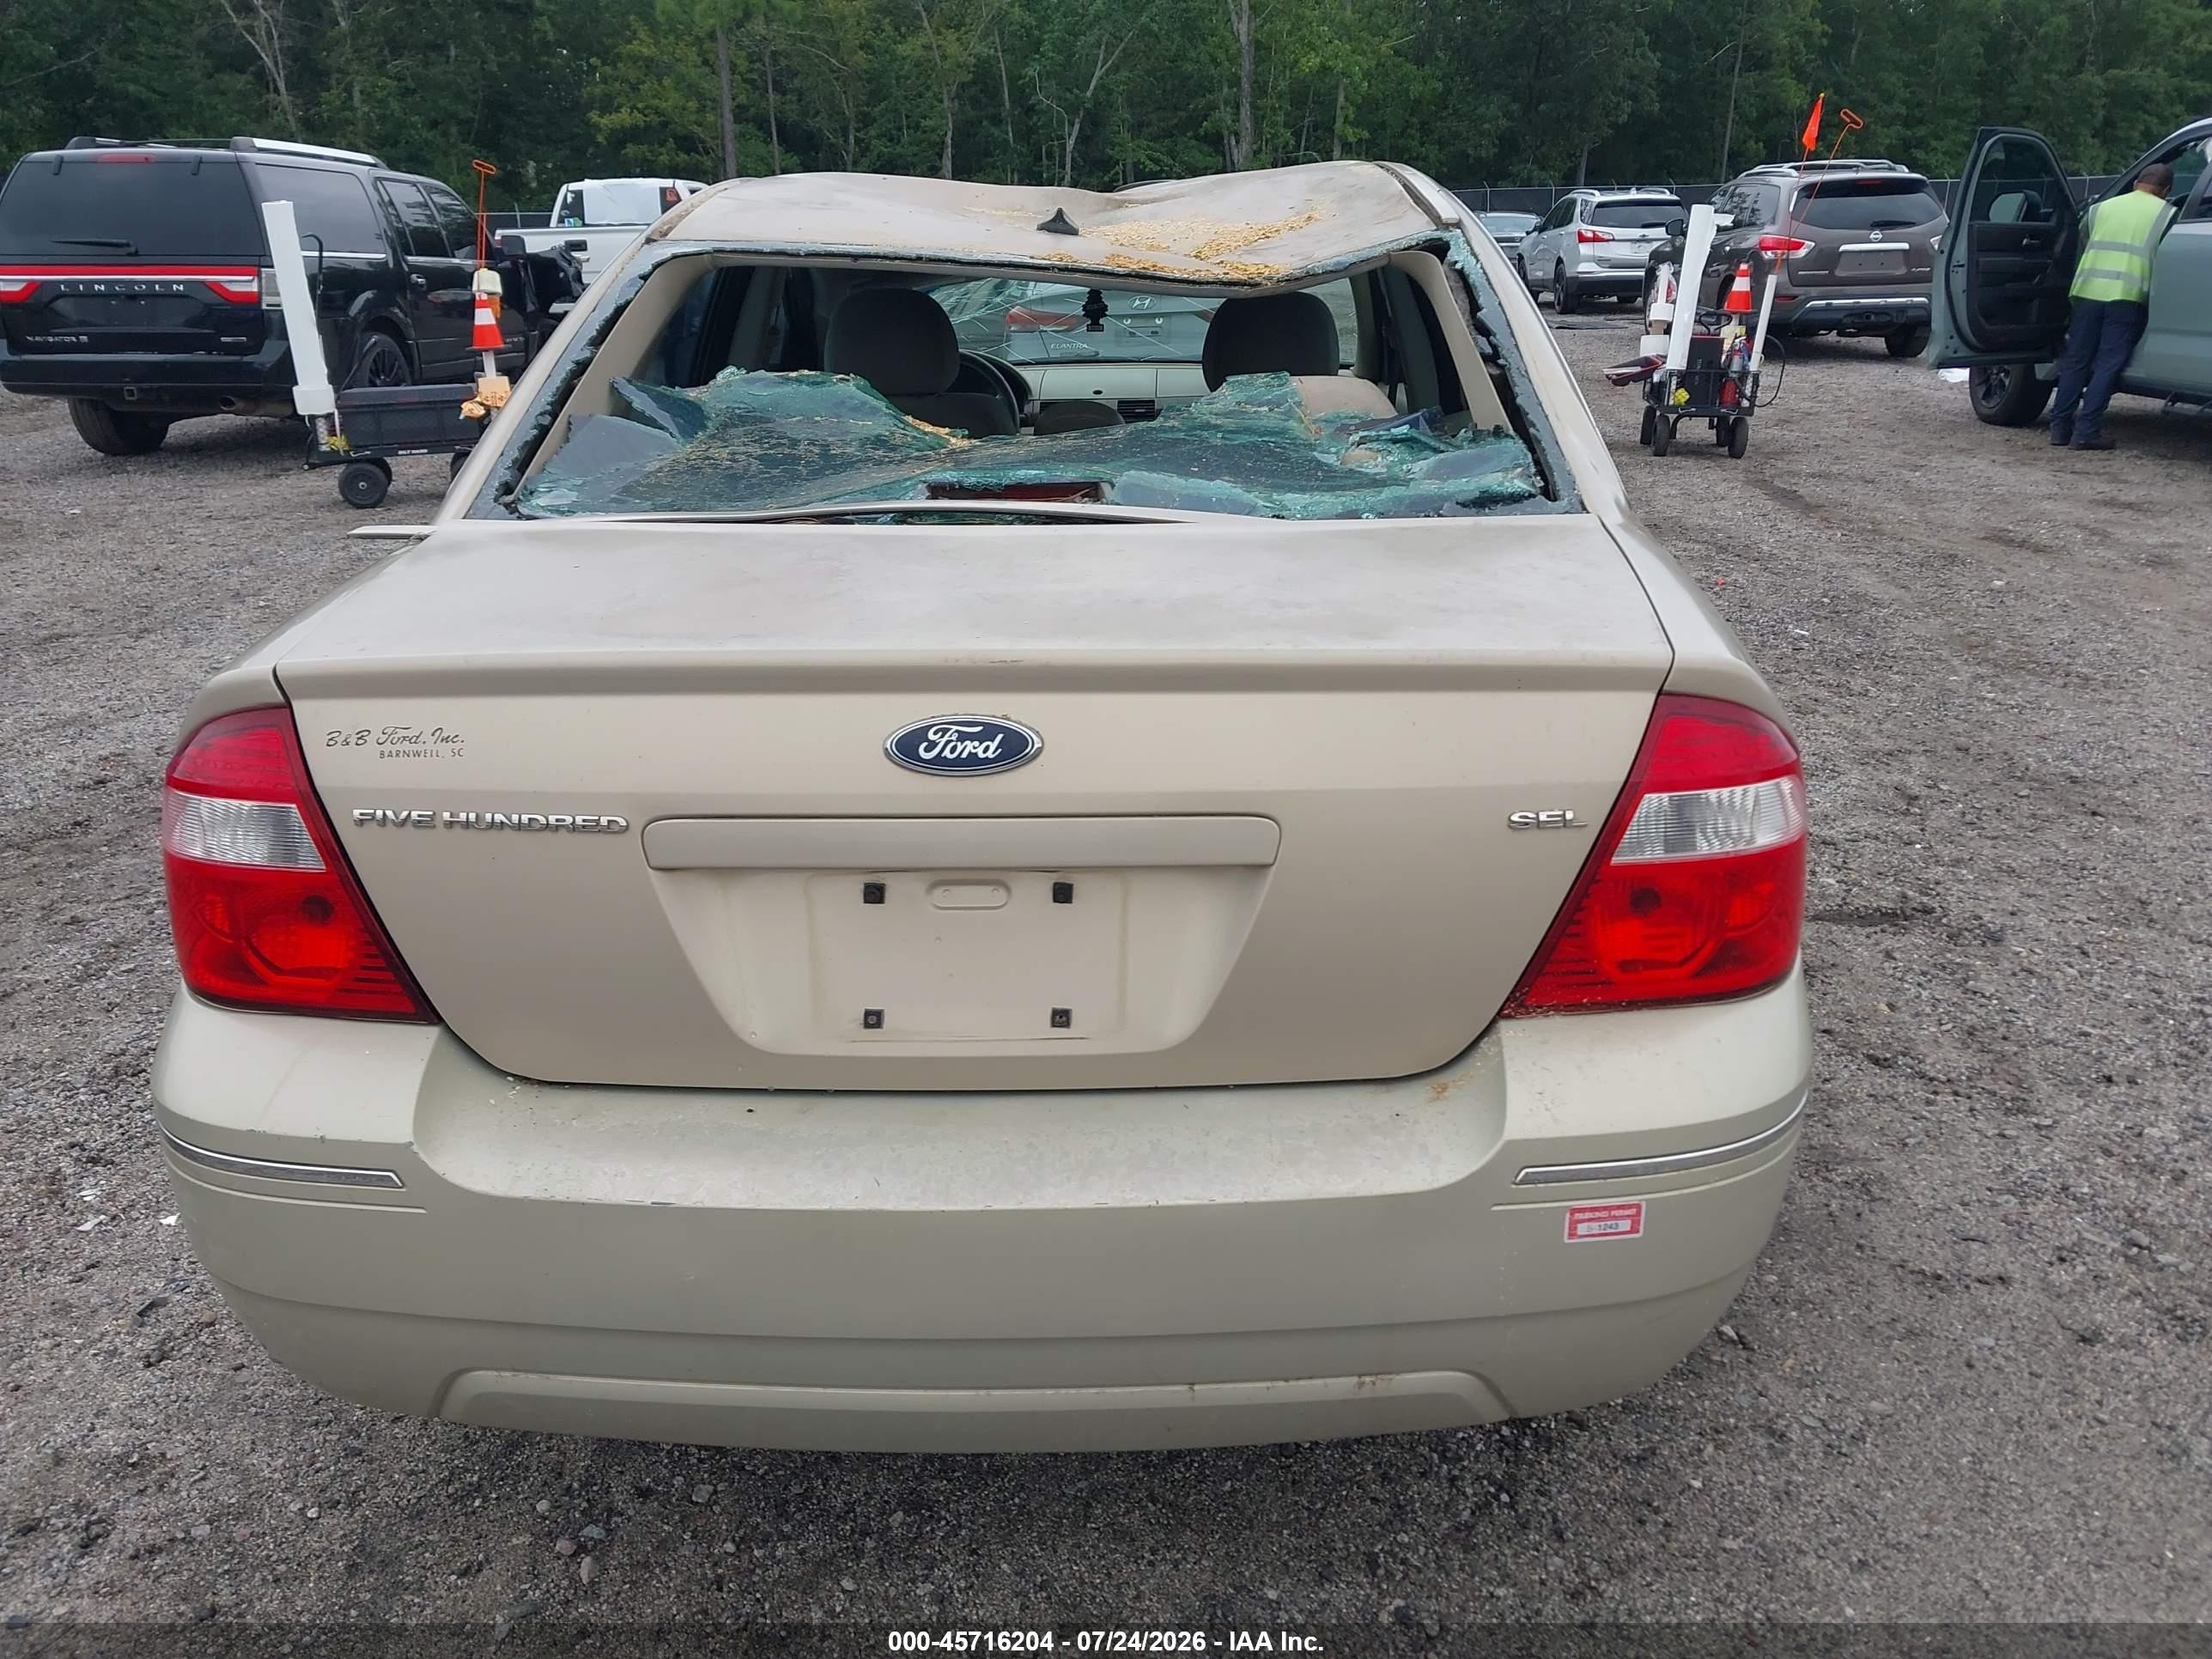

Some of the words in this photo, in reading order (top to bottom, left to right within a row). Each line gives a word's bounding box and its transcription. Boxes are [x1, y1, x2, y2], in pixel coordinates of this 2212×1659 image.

[325, 729, 371, 747] B&B
[431, 726, 465, 744] Inc.
[918, 725, 1005, 760] Ford
[450, 748, 465, 757] SC
[352, 809, 436, 829] FIVE
[442, 811, 629, 835] HUNDRED
[1508, 810, 1587, 830] SEL
